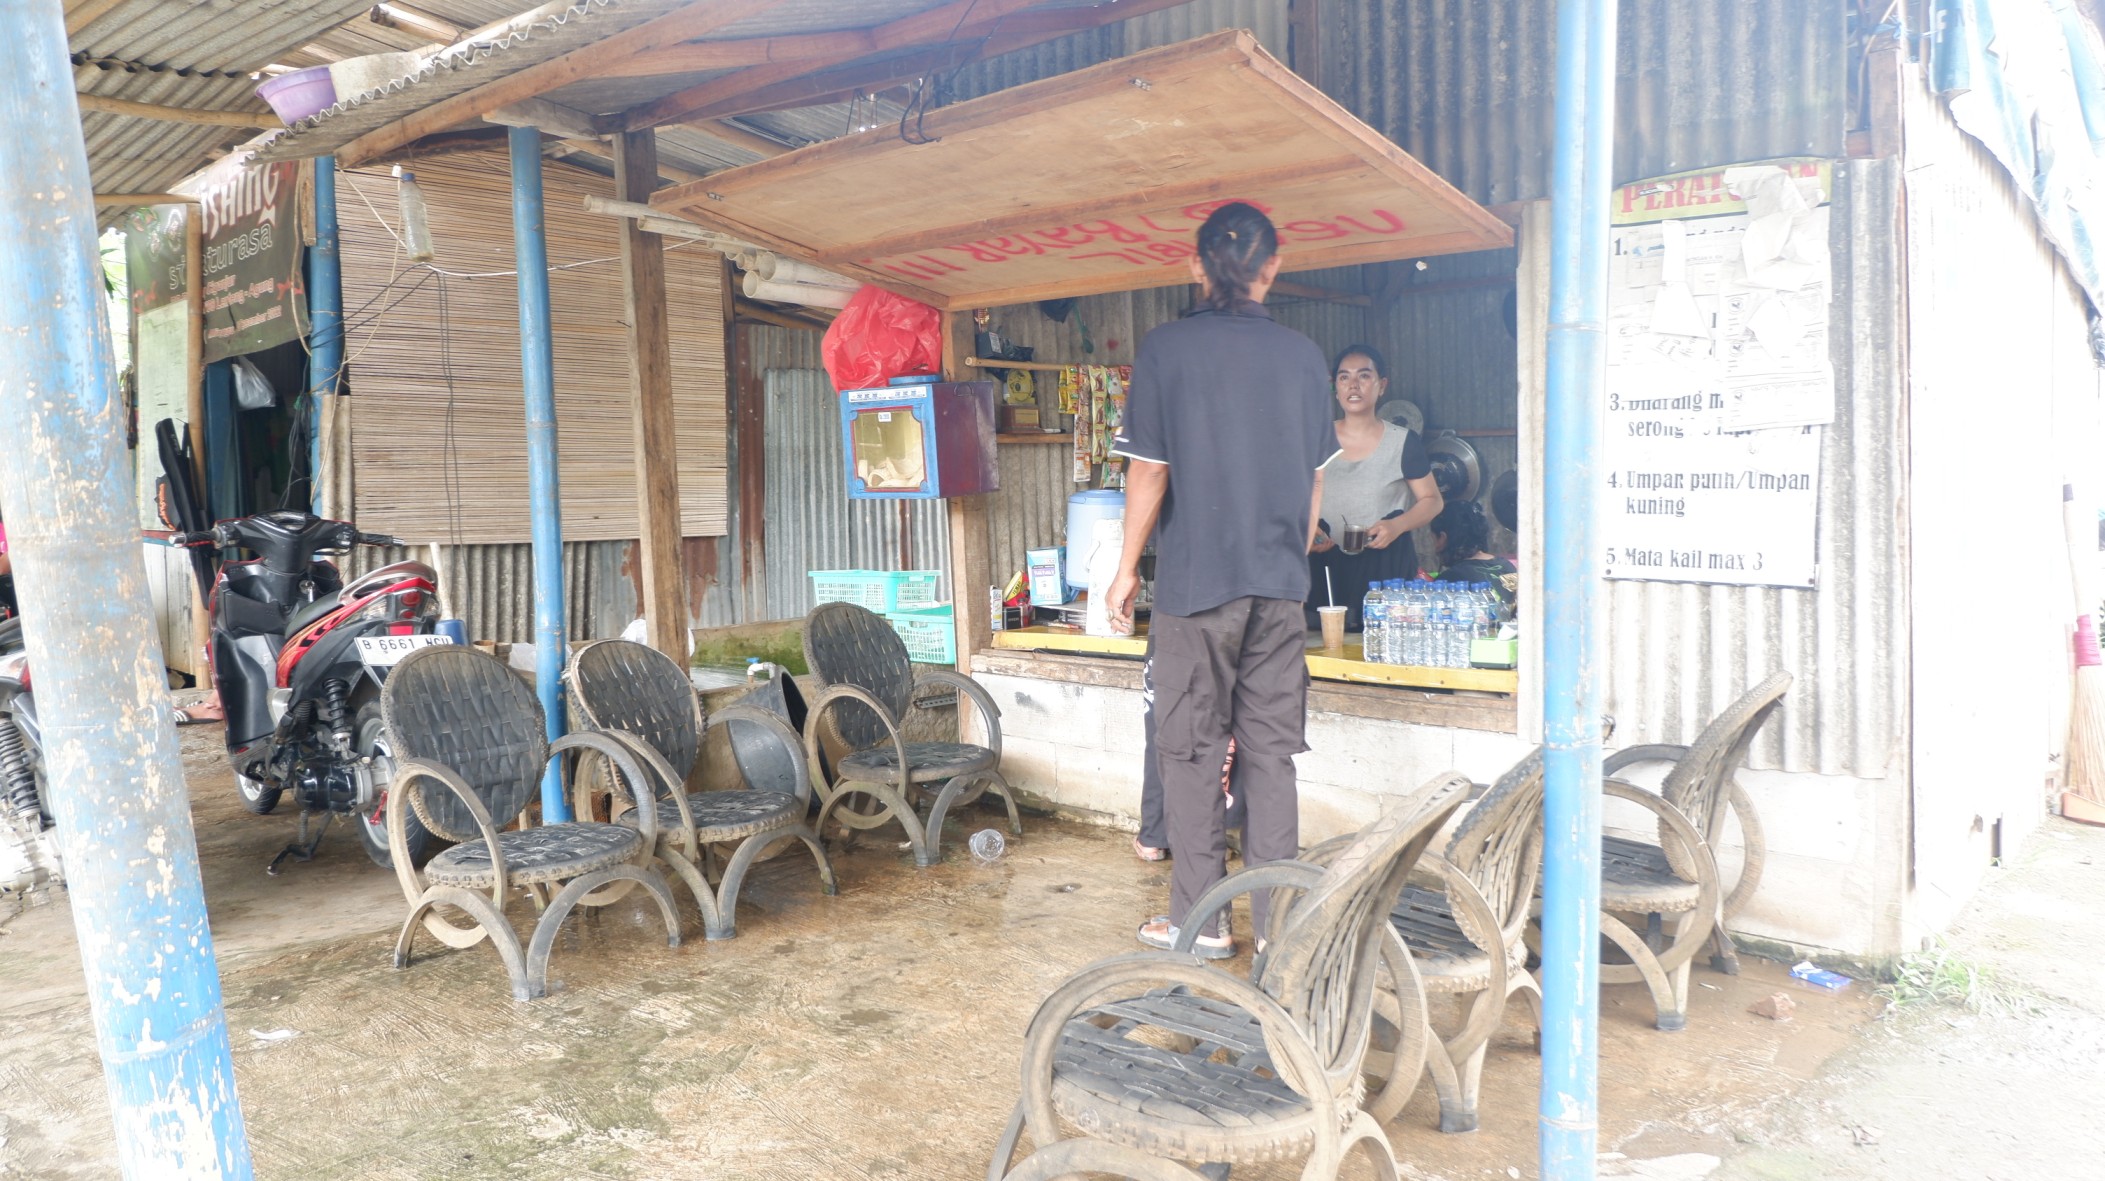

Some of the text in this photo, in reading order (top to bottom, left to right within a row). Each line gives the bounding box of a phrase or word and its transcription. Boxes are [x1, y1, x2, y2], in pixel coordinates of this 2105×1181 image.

[1609, 392, 1626, 411] 3.
[1626, 496, 1685, 518] kuning
[1625, 547, 1664, 567] Mata
[1669, 549, 1702, 570] kail
[1708, 551, 1746, 571] max
[1752, 552, 1764, 571] 3
[362, 639, 372, 650] B
[379, 638, 416, 651] 6661
